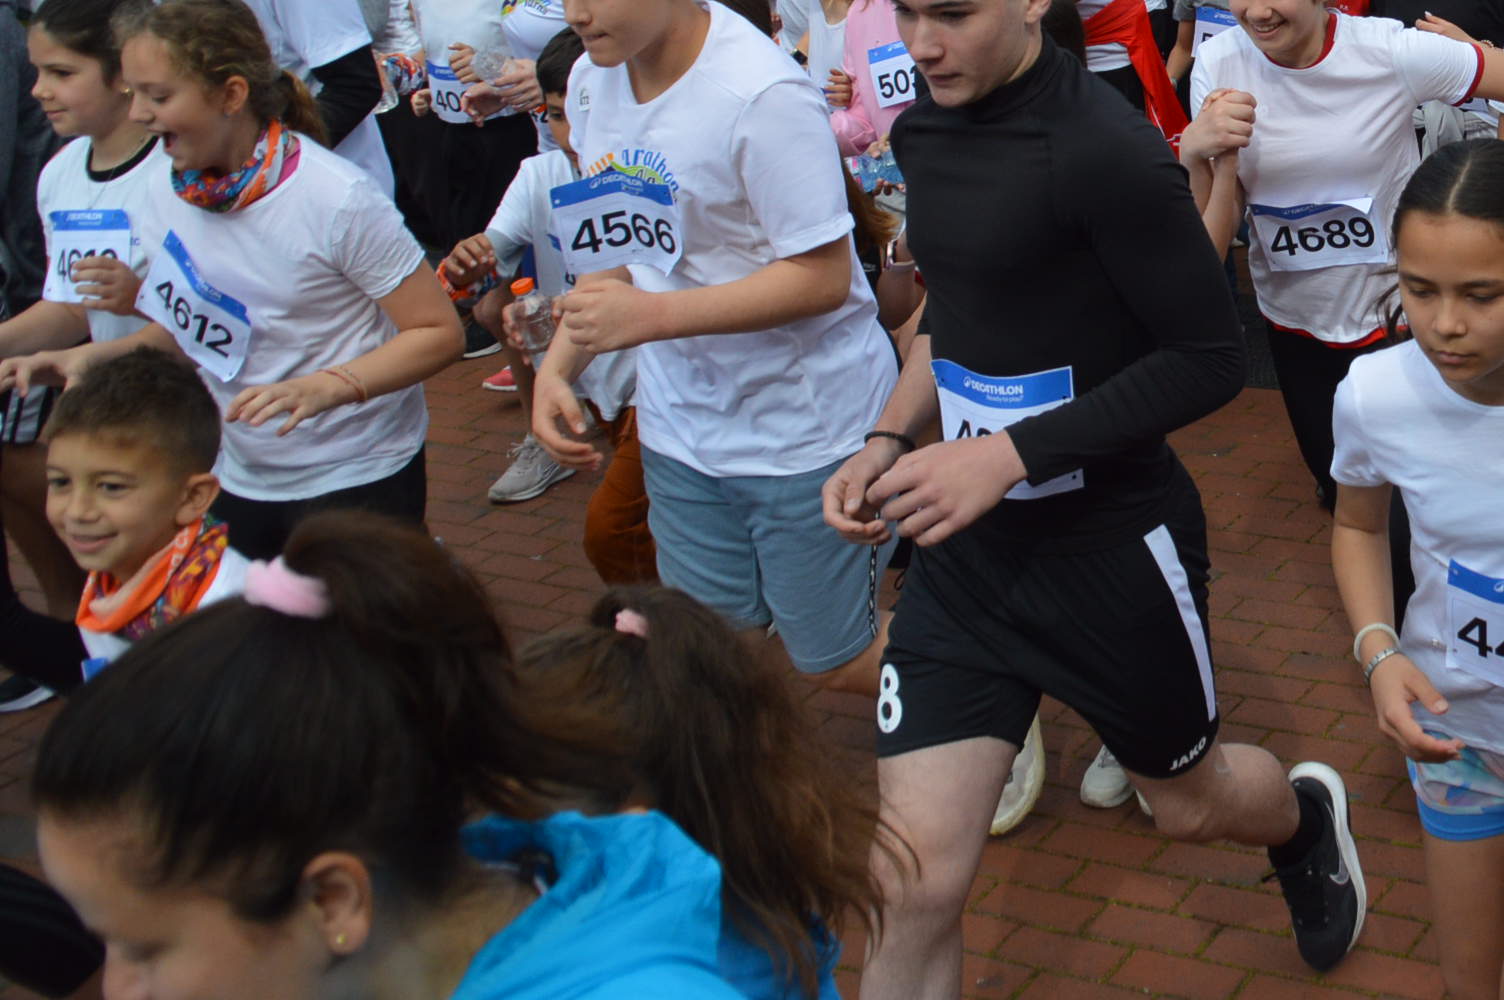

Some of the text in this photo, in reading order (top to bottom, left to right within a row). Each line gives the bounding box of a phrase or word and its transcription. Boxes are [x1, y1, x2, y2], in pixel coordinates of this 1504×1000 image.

[622, 149, 680, 192] arathon
[571, 210, 676, 255] 4566
[1271, 216, 1375, 257] 4689
[155, 280, 233, 358] 4612
[971, 380, 1024, 395] DECATHLON
[877, 663, 903, 734] 8
[1170, 736, 1207, 772] JAKO
